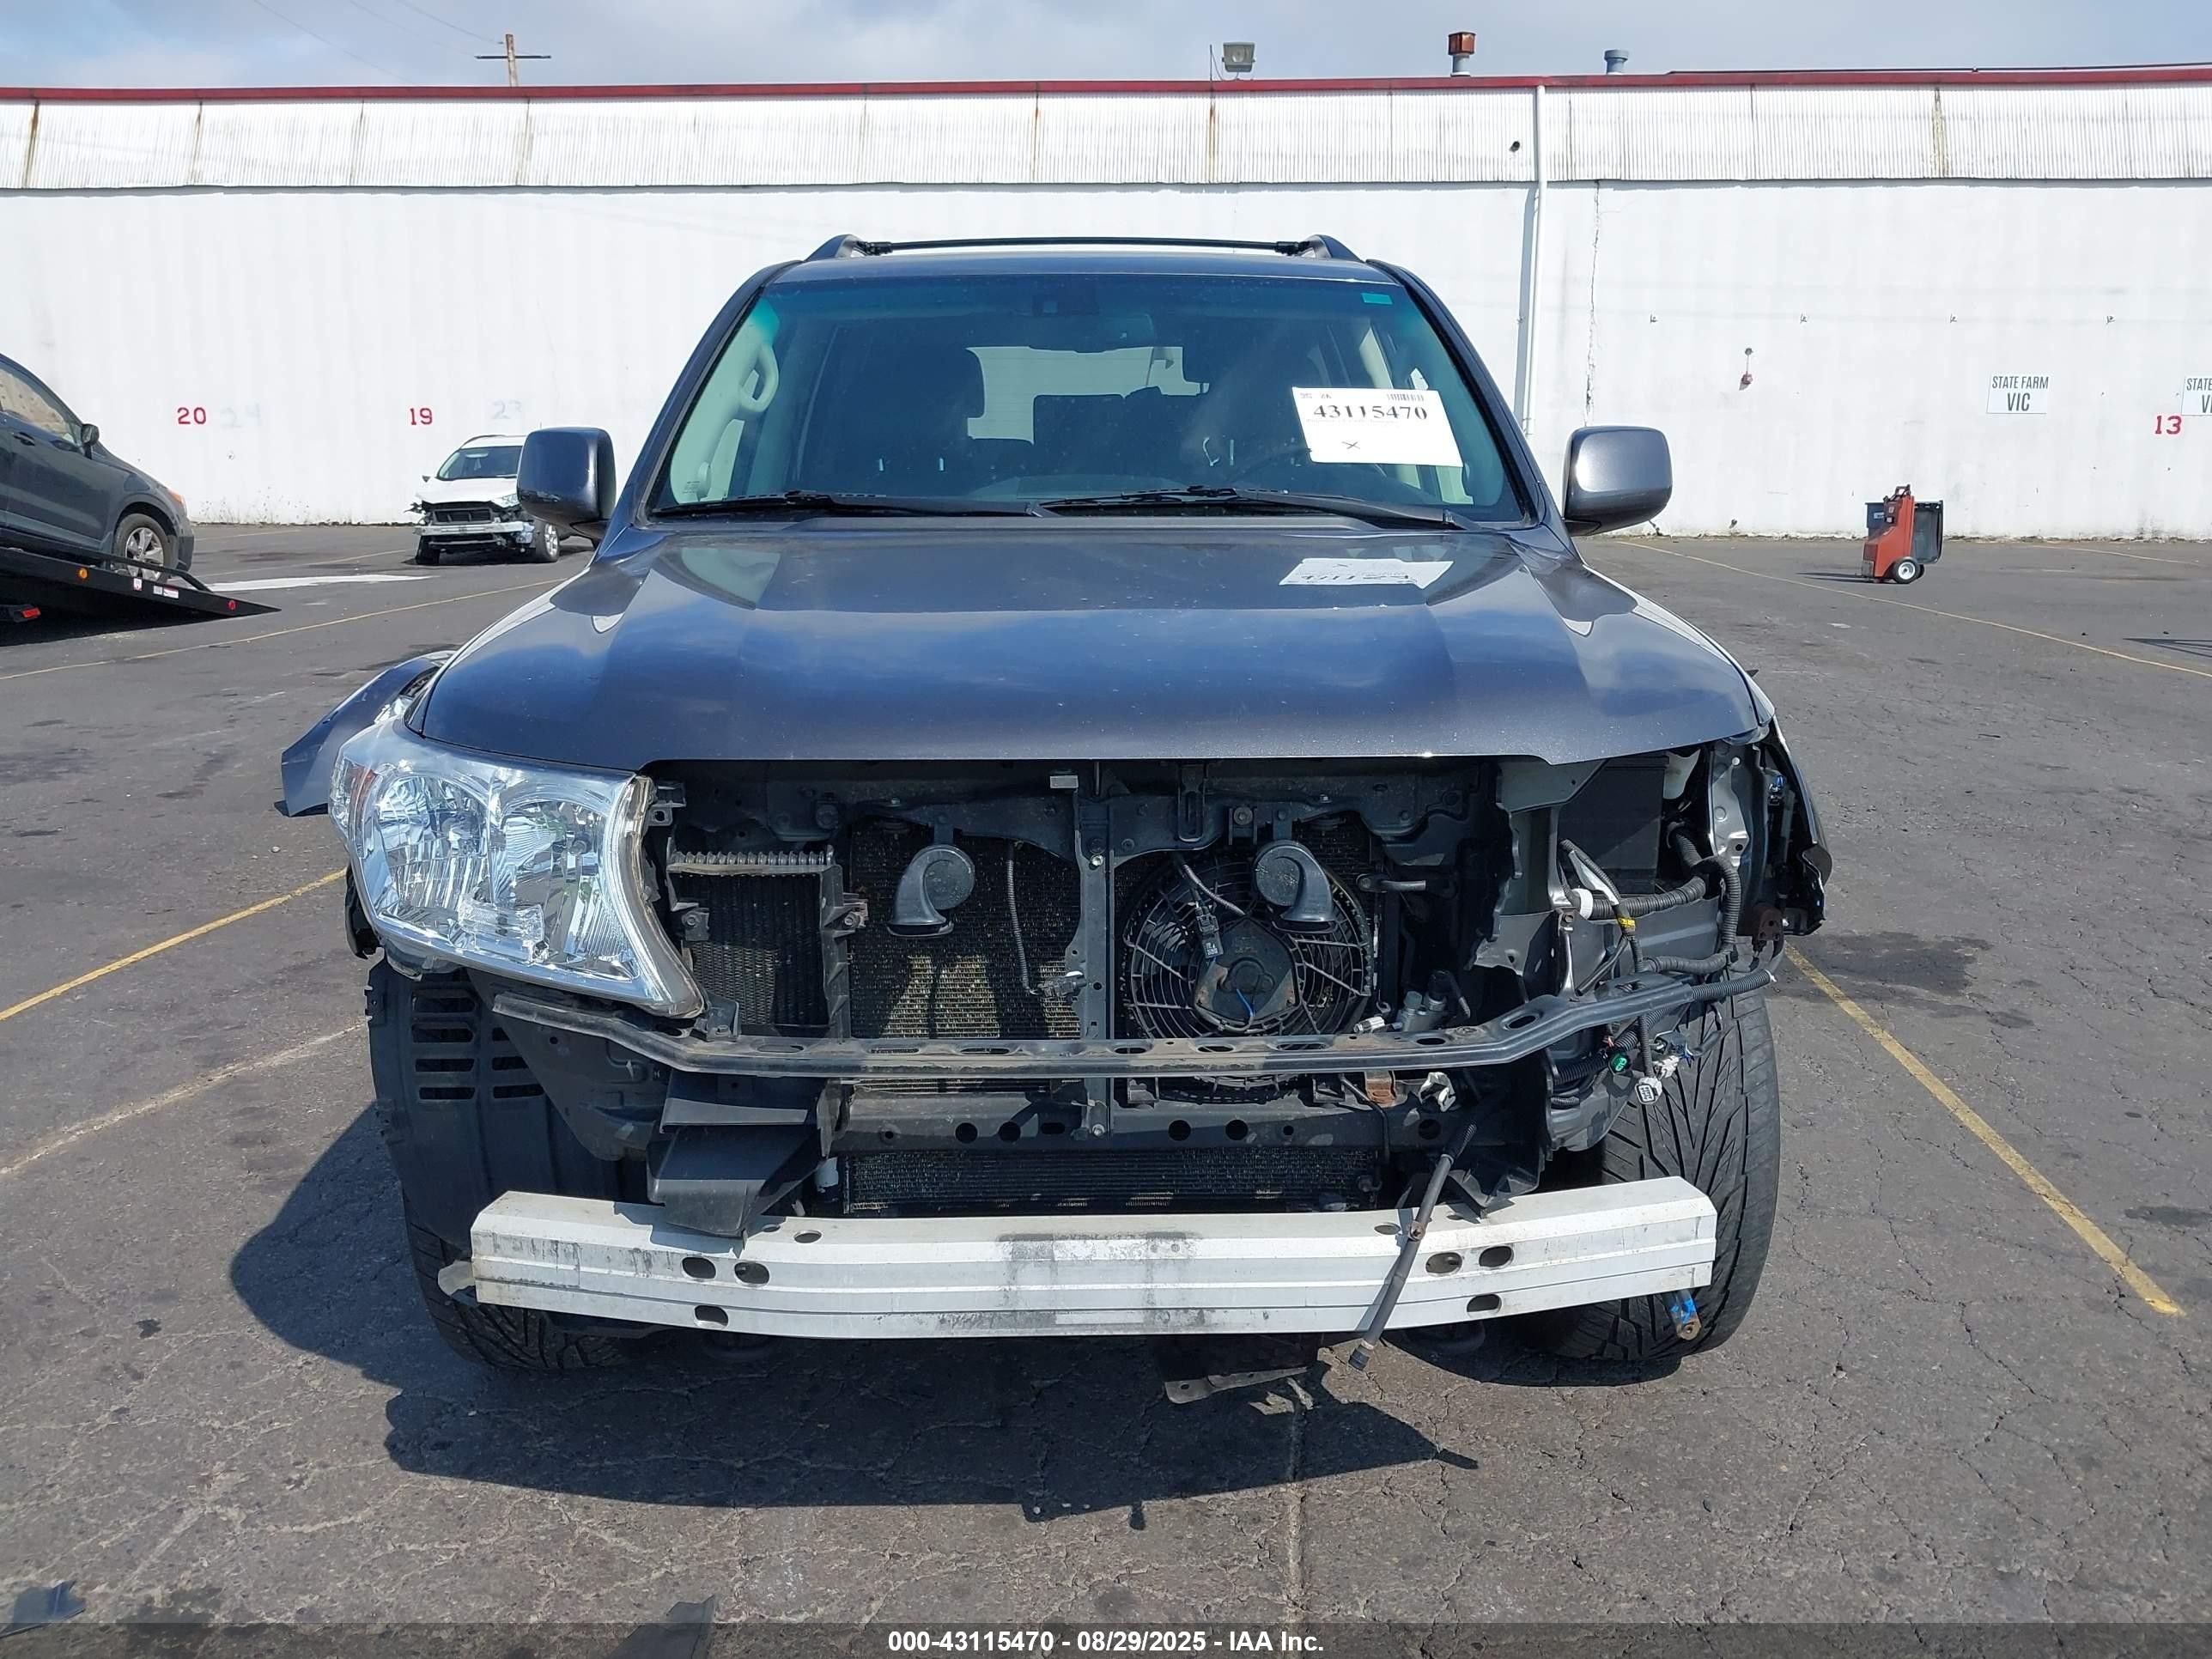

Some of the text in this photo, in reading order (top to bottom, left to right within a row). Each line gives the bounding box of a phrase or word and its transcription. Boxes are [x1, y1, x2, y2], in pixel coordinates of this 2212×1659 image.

[1991, 375, 2050, 389] STATE FARM
[2186, 377, 2212, 392] STATE
[2007, 392, 2031, 411] VIC
[177, 407, 207, 425] 20
[410, 408, 434, 425] 19
[1313, 404, 1428, 420] 43115470
[2154, 415, 2182, 435] 13
